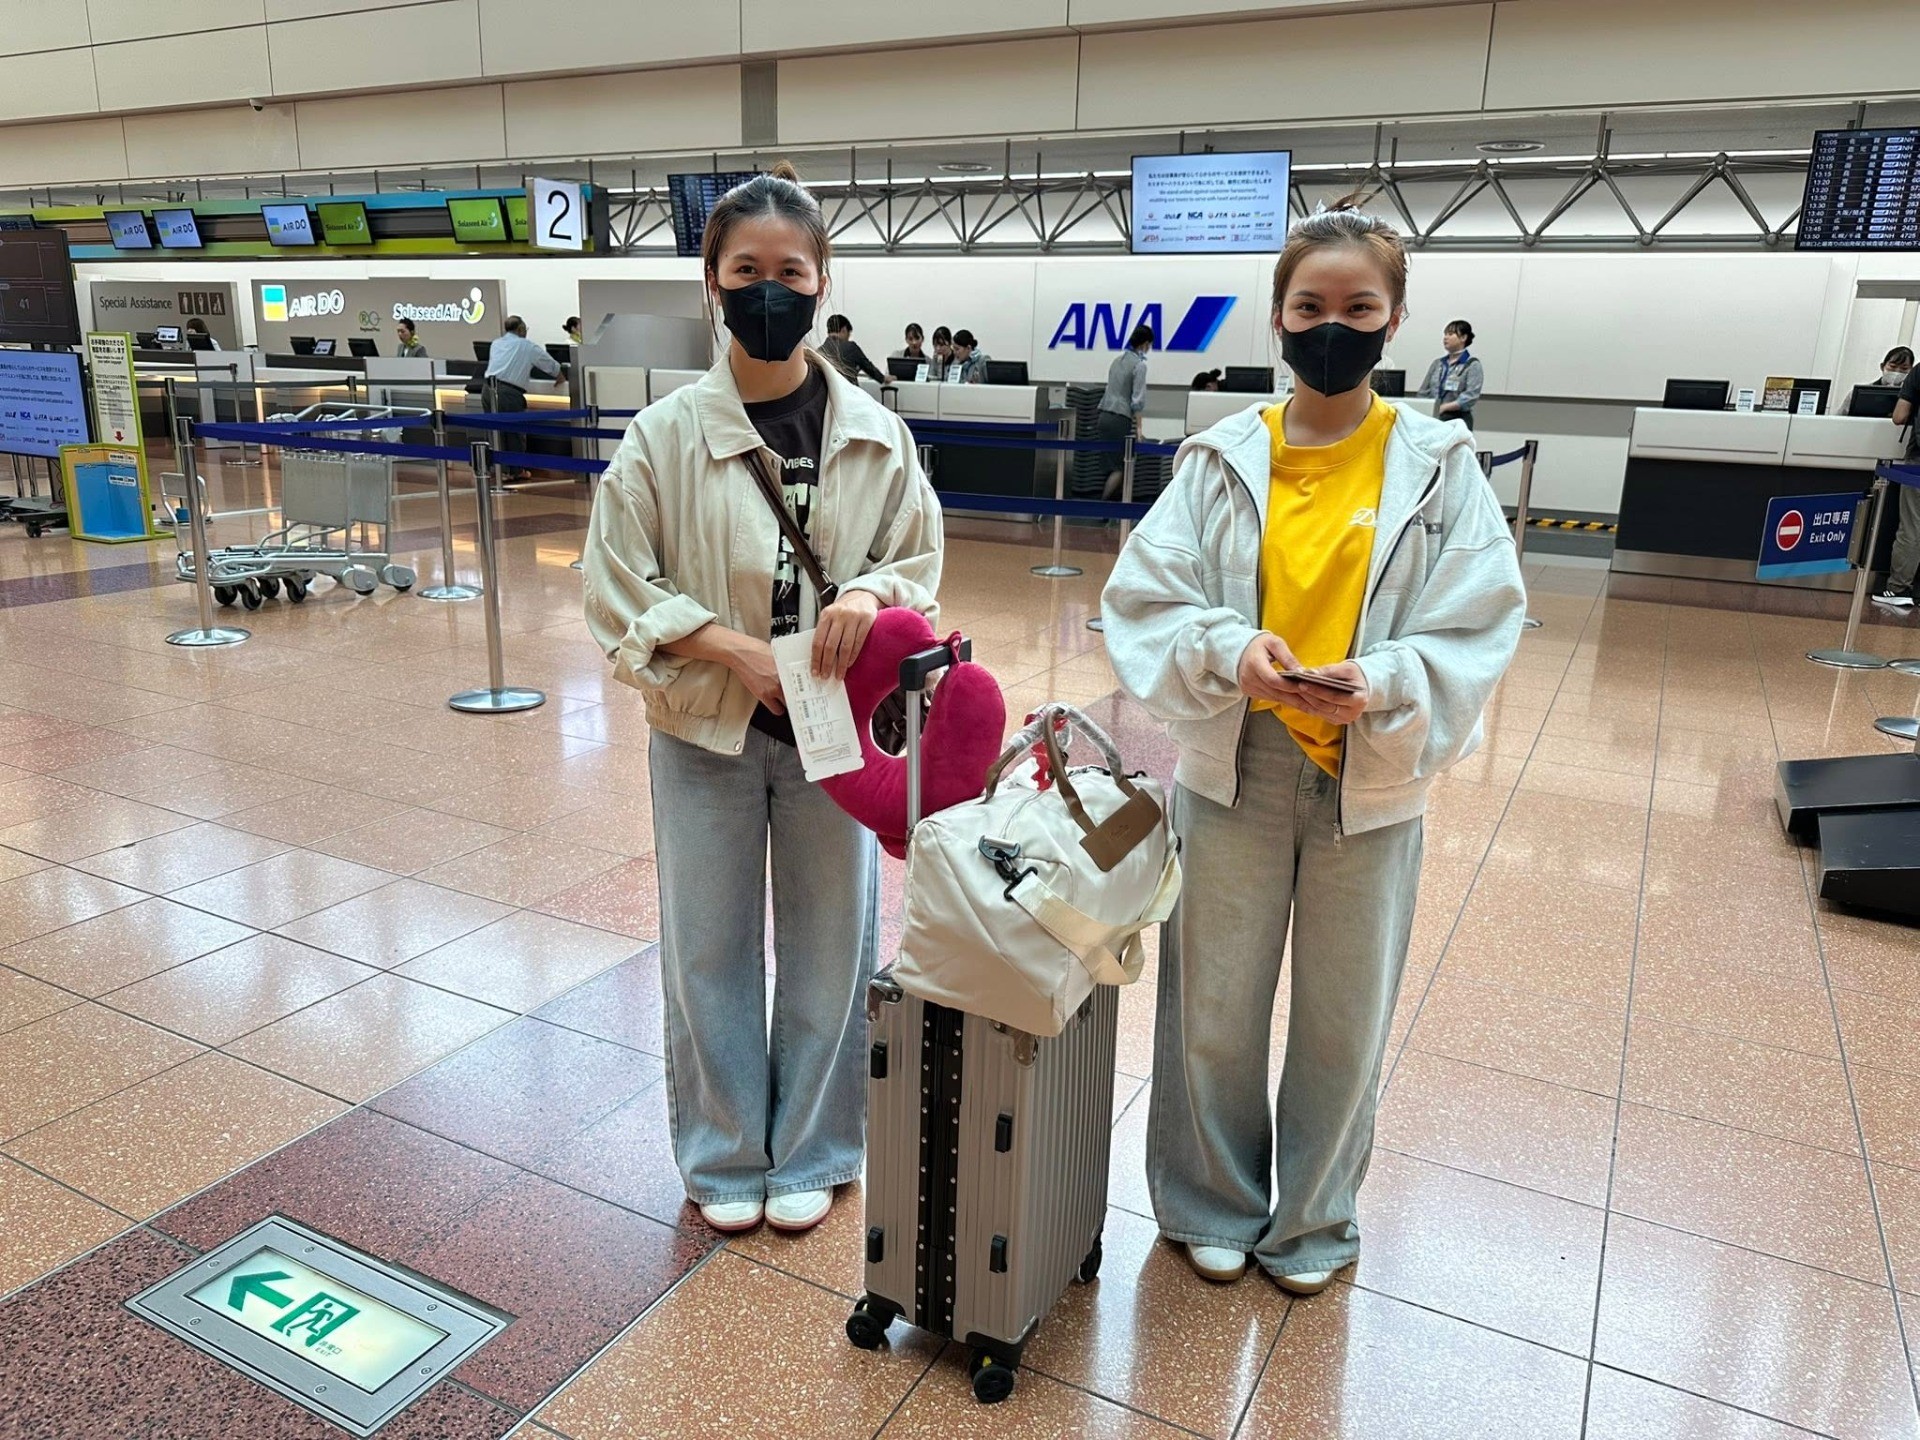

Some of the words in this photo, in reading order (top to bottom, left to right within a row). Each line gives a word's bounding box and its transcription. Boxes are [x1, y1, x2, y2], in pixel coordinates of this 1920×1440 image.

[548, 190, 572, 240] 2
[124, 227, 133, 235] AIR
[135, 224, 144, 234] DO
[172, 225, 182, 234] AIR
[184, 223, 194, 233] DO
[283, 222, 294, 231] AIR
[296, 219, 306, 230] DO
[100, 296, 127, 310] Special
[130, 297, 172, 309] Assistance
[289, 295, 317, 318] AIR
[317, 289, 344, 316] DO
[393, 303, 443, 321] Solaseed
[444, 304, 462, 321] Air
[1048, 303, 1162, 351] ANA
[782, 457, 814, 469] VIBES
[1813, 510, 1850, 526] 出口専用
[1810, 532, 1825, 543] Exit
[1827, 530, 1846, 543] Only
